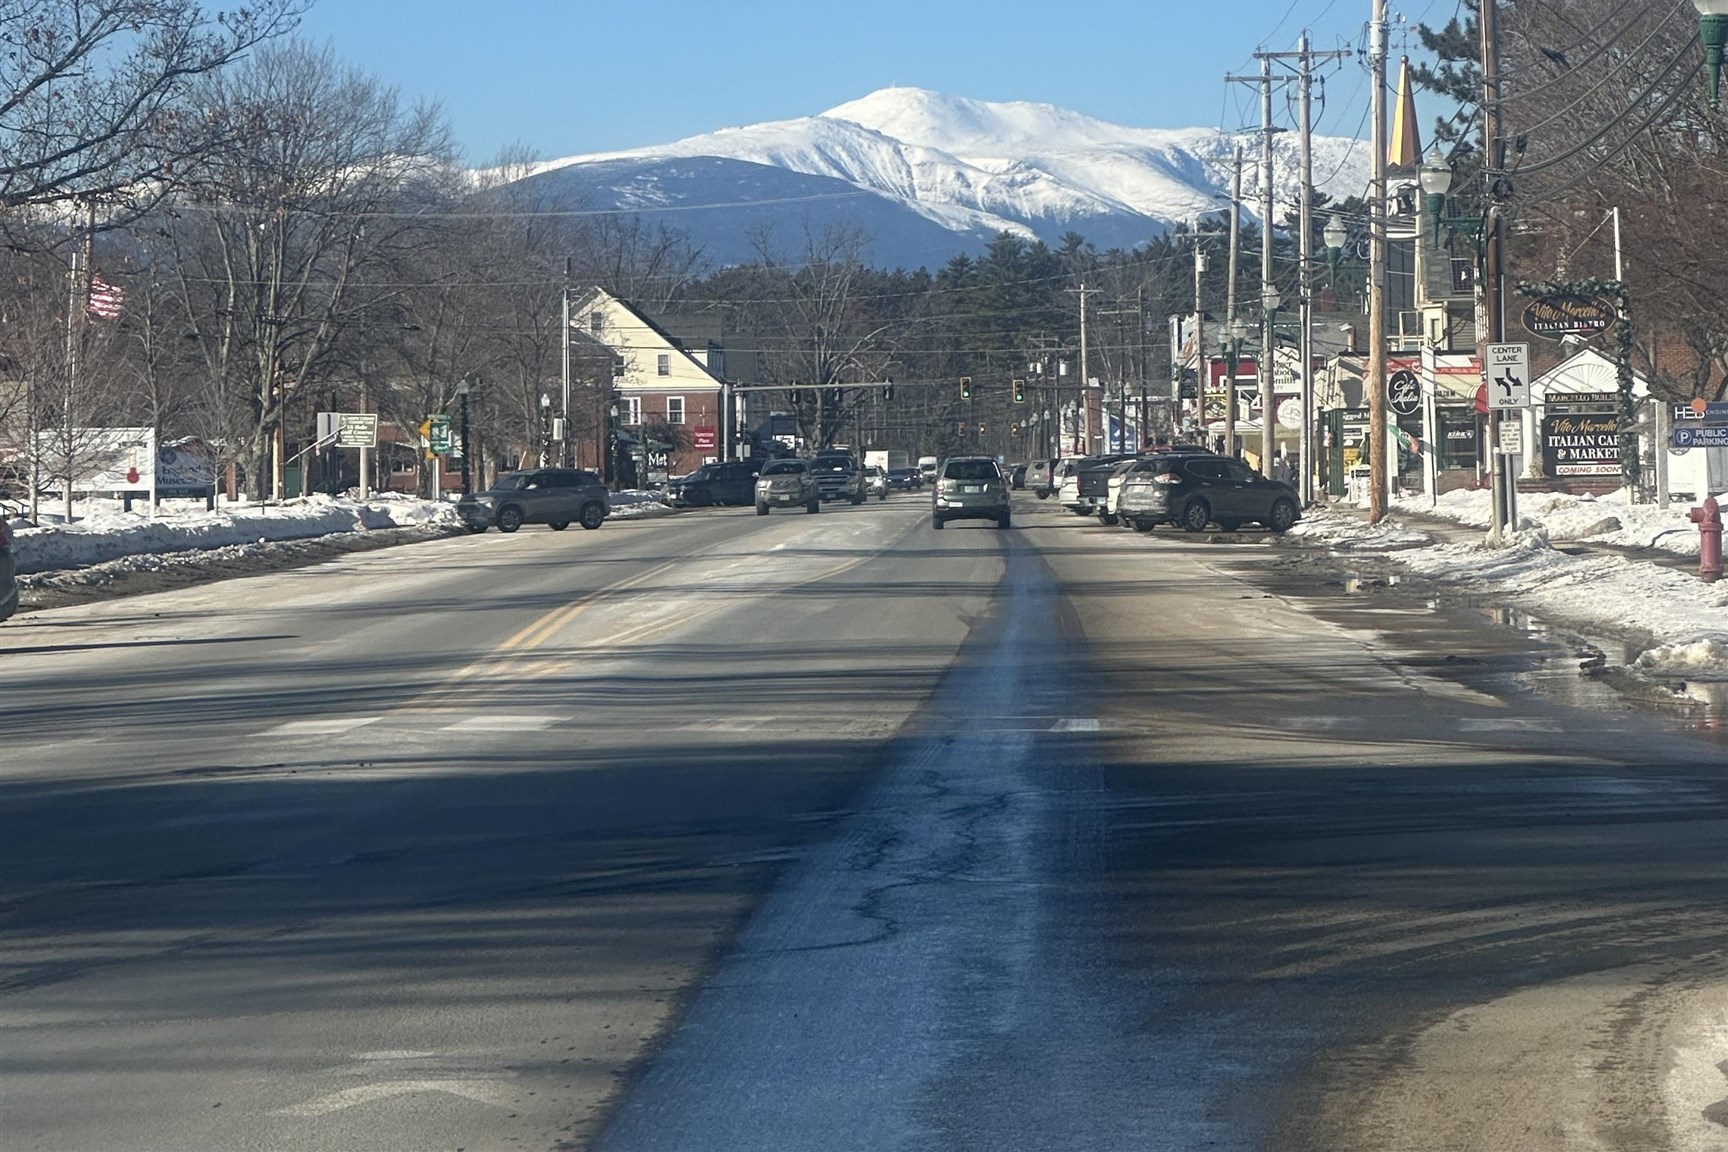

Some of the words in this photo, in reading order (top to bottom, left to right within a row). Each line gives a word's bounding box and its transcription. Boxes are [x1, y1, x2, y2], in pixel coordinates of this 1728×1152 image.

[1534, 320, 1569, 330] ITALIAN
[1573, 319, 1605, 329] BISTRO
[1492, 346, 1522, 354] CENTER
[1496, 354, 1518, 362] LANE
[1499, 398, 1519, 406] ONLY
[1551, 418, 1573, 434] Vito
[1571, 418, 1618, 436] Marcello
[1548, 435, 1595, 447] ITALIAN
[1597, 435, 1621, 446] CAF
[1680, 432, 1689, 443] P
[1695, 429, 1727, 438] PUBLIC
[1692, 437, 1728, 446] PARKING
[648, 452, 668, 466] Met
[1557, 448, 1567, 460] &
[1570, 448, 1621, 459] MARKET
[1558, 466, 1592, 474] COMING
